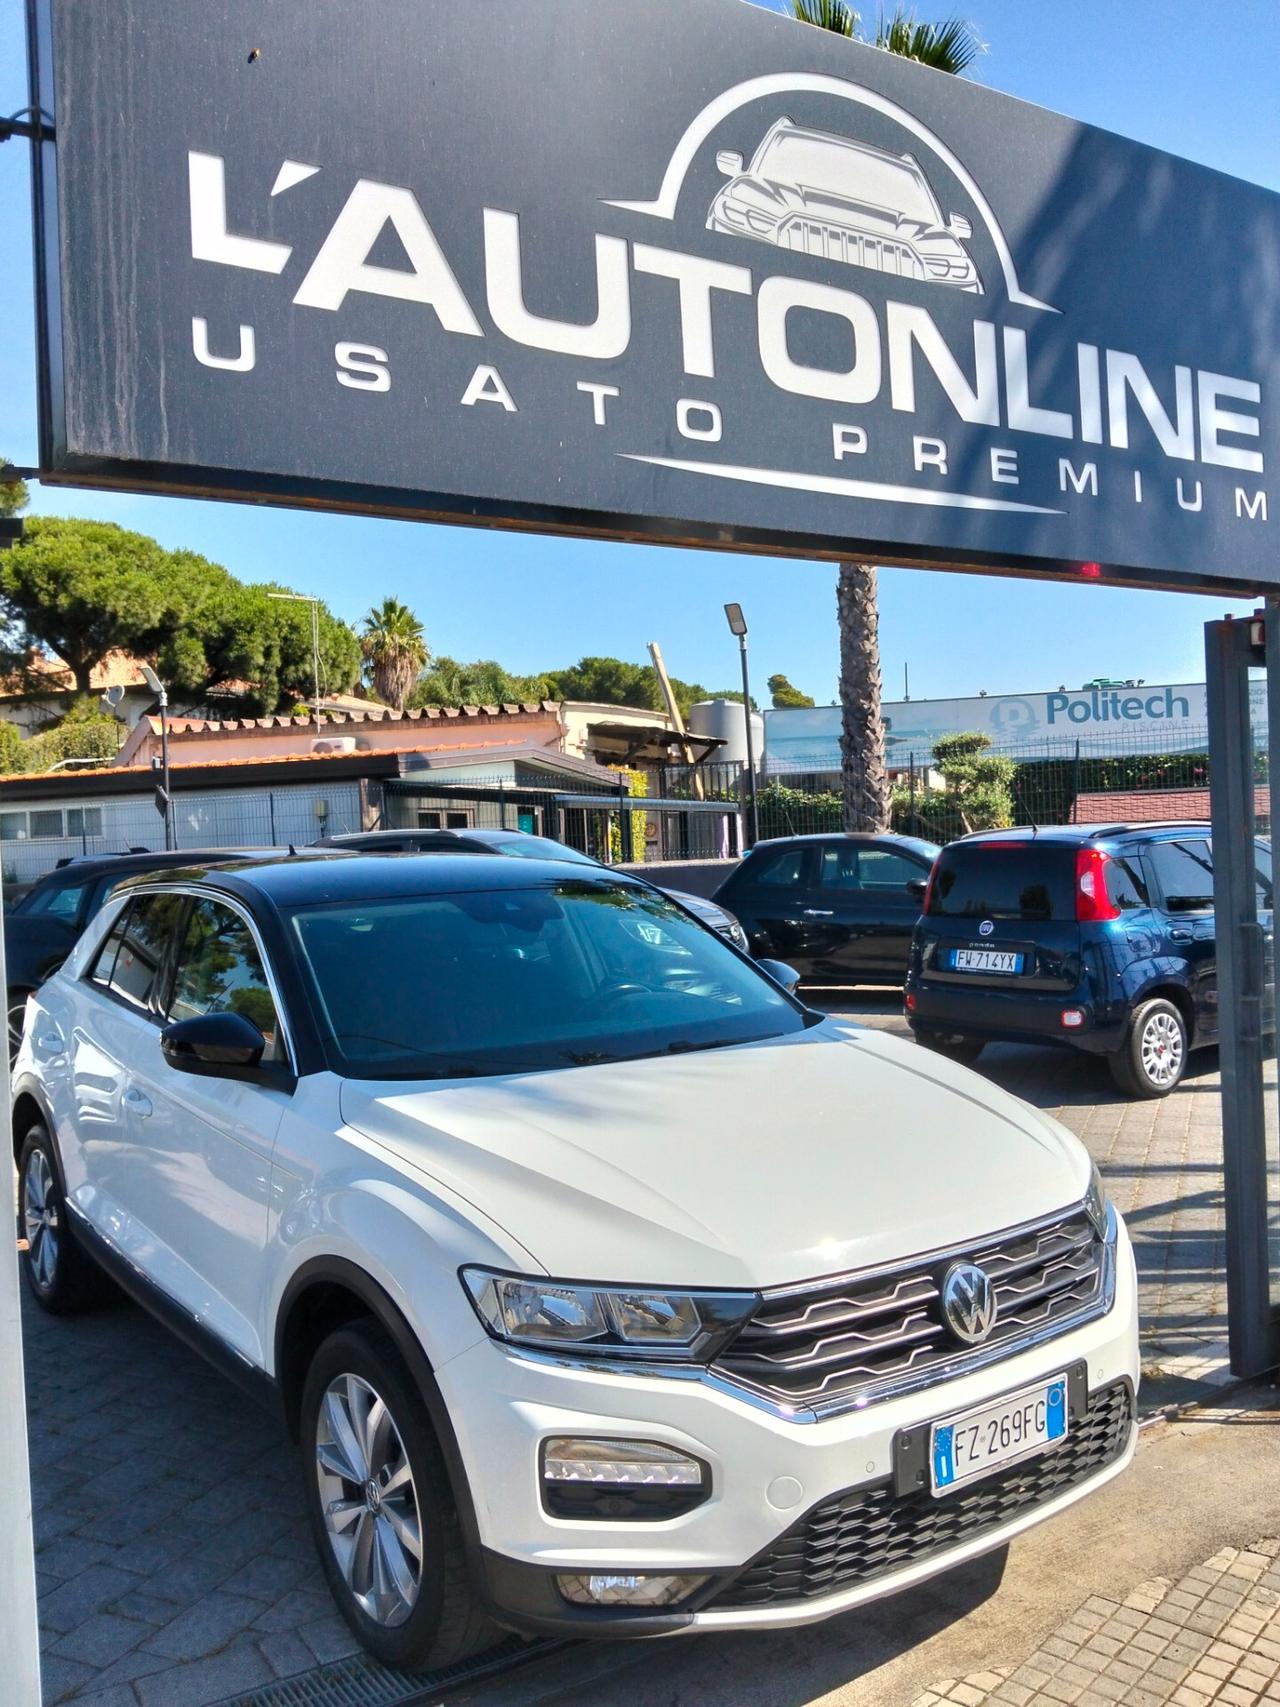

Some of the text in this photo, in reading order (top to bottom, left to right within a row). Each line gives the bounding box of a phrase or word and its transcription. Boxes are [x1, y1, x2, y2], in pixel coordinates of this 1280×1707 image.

[192, 316, 1269, 521] USATO PREMIUM
[1047, 688, 1189, 724] Politech
